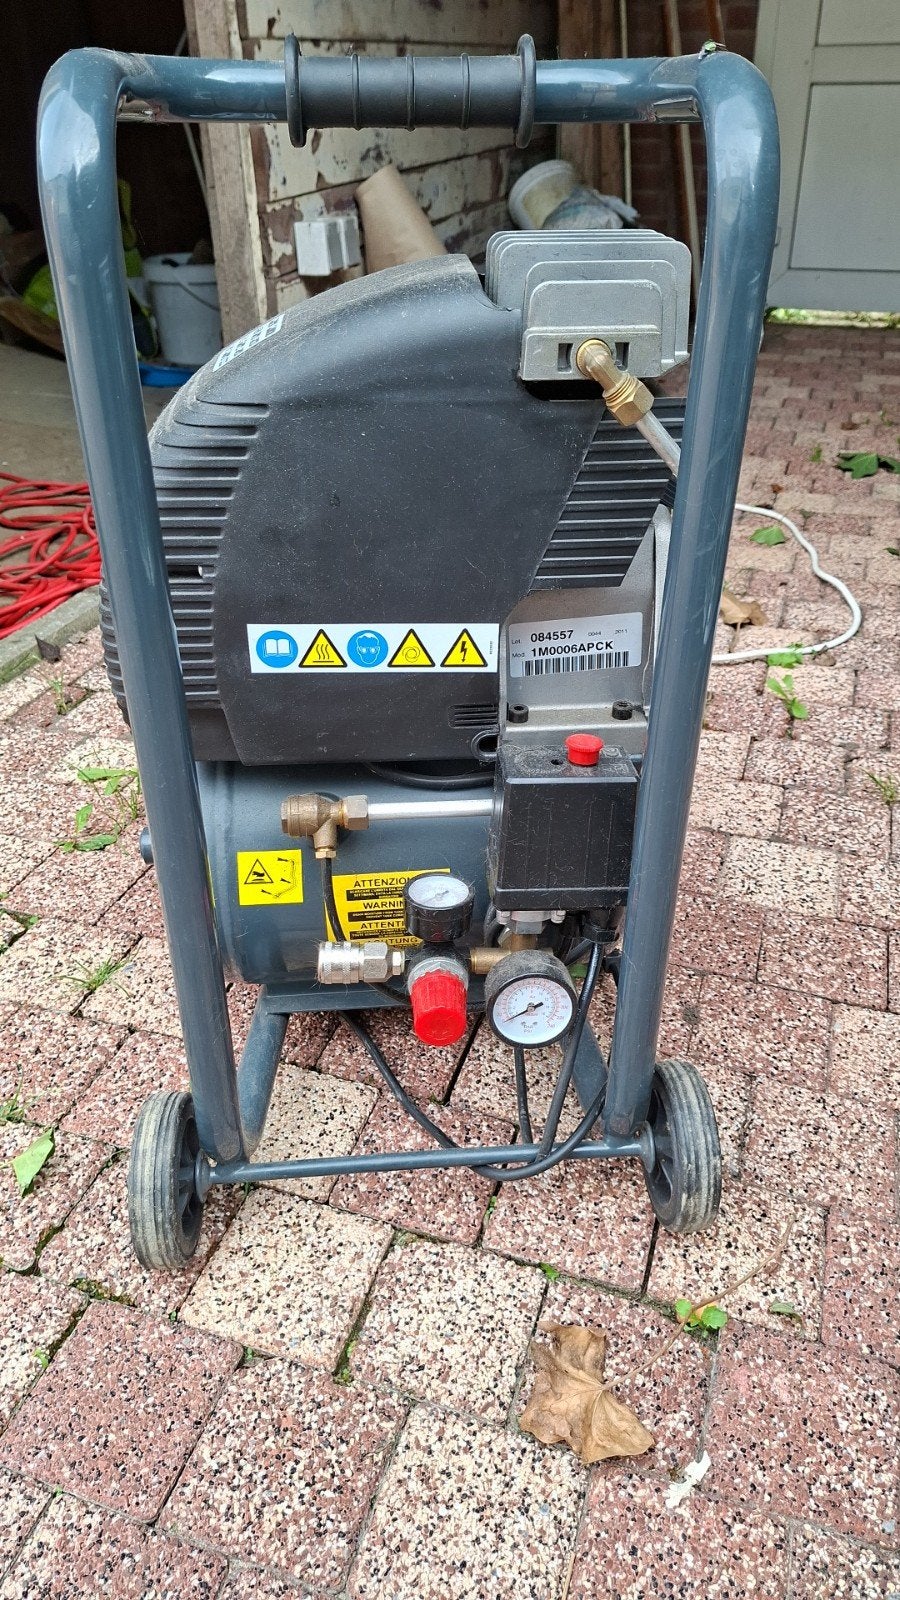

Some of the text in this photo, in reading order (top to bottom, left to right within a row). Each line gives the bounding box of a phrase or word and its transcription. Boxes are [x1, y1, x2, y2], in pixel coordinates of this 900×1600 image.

[530, 630, 574, 642] 084557
[531, 640, 614, 657] 1M0006APCK
[354, 877, 408, 887] ATTENZIO
[363, 901, 404, 909] WARNIN
[361, 921, 404, 929] ATTENTI
